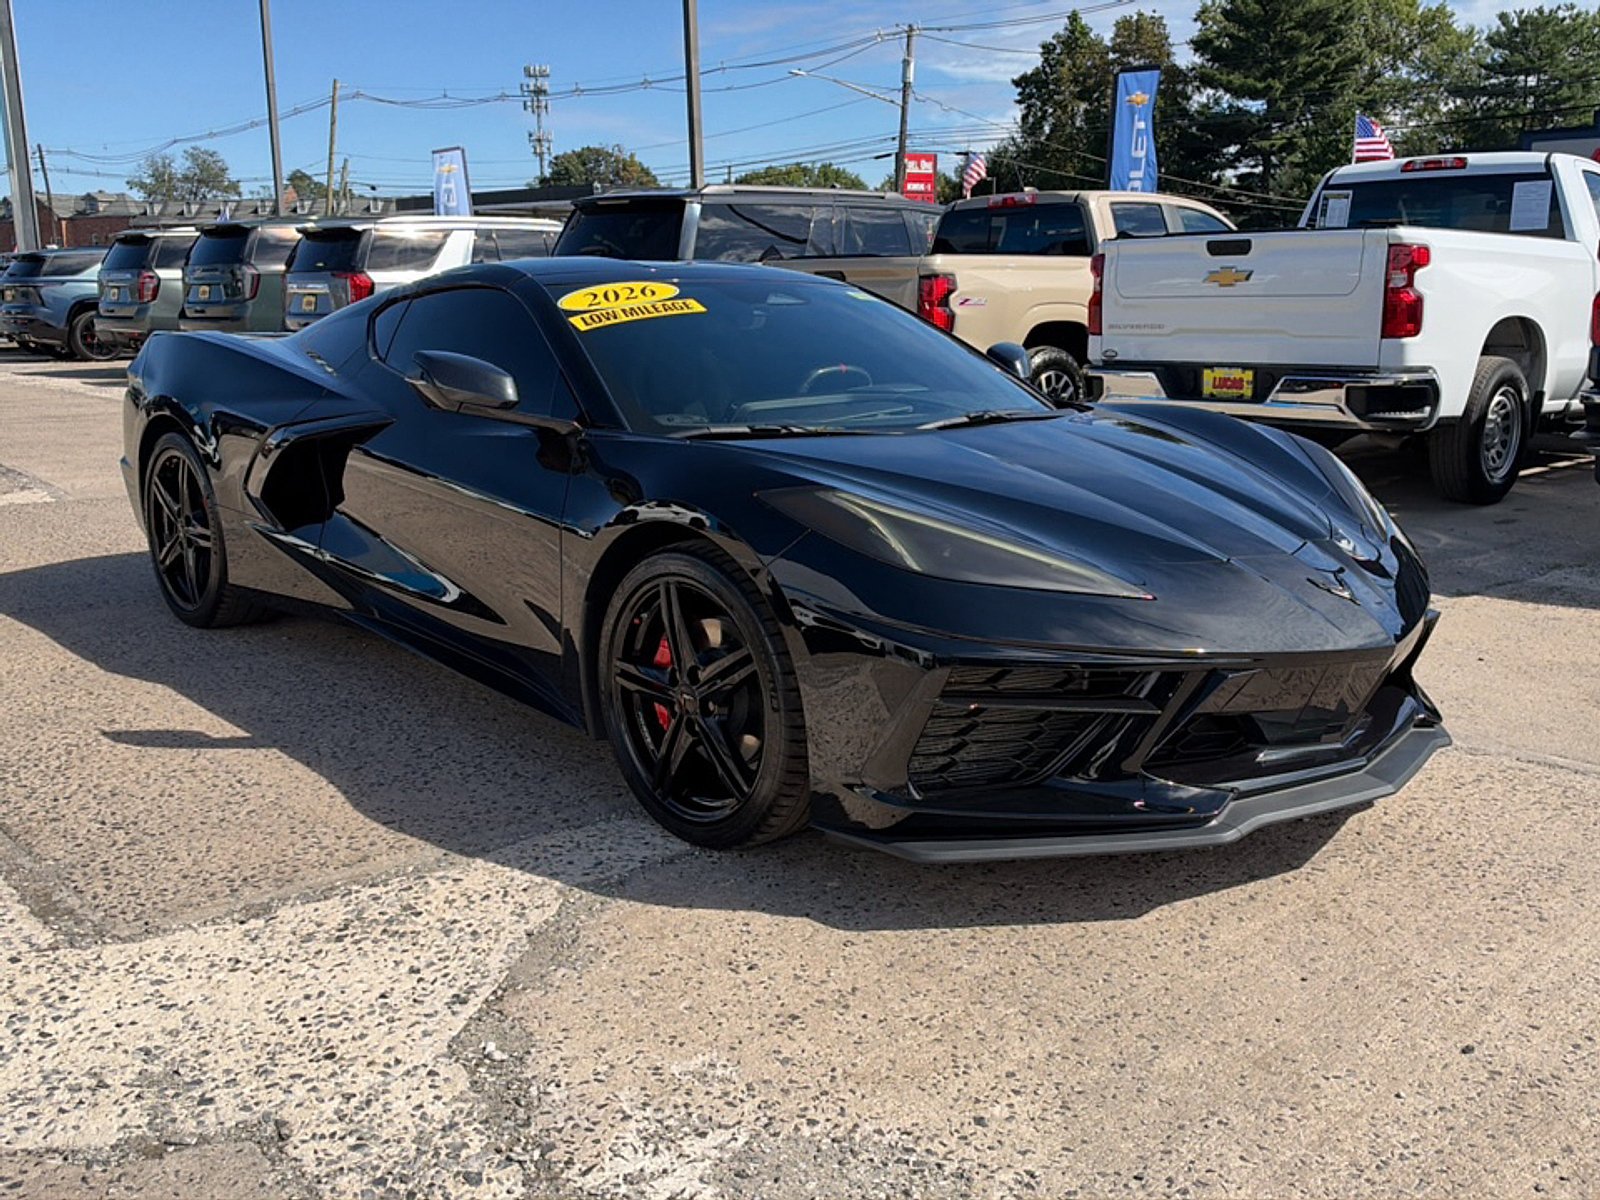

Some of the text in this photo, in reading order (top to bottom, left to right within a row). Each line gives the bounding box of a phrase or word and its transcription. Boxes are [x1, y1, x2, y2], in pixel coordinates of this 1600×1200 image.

[584, 285, 657, 307] 2026
[580, 301, 695, 327] LOW MILEAGE
[1212, 376, 1245, 390] LUCAS
